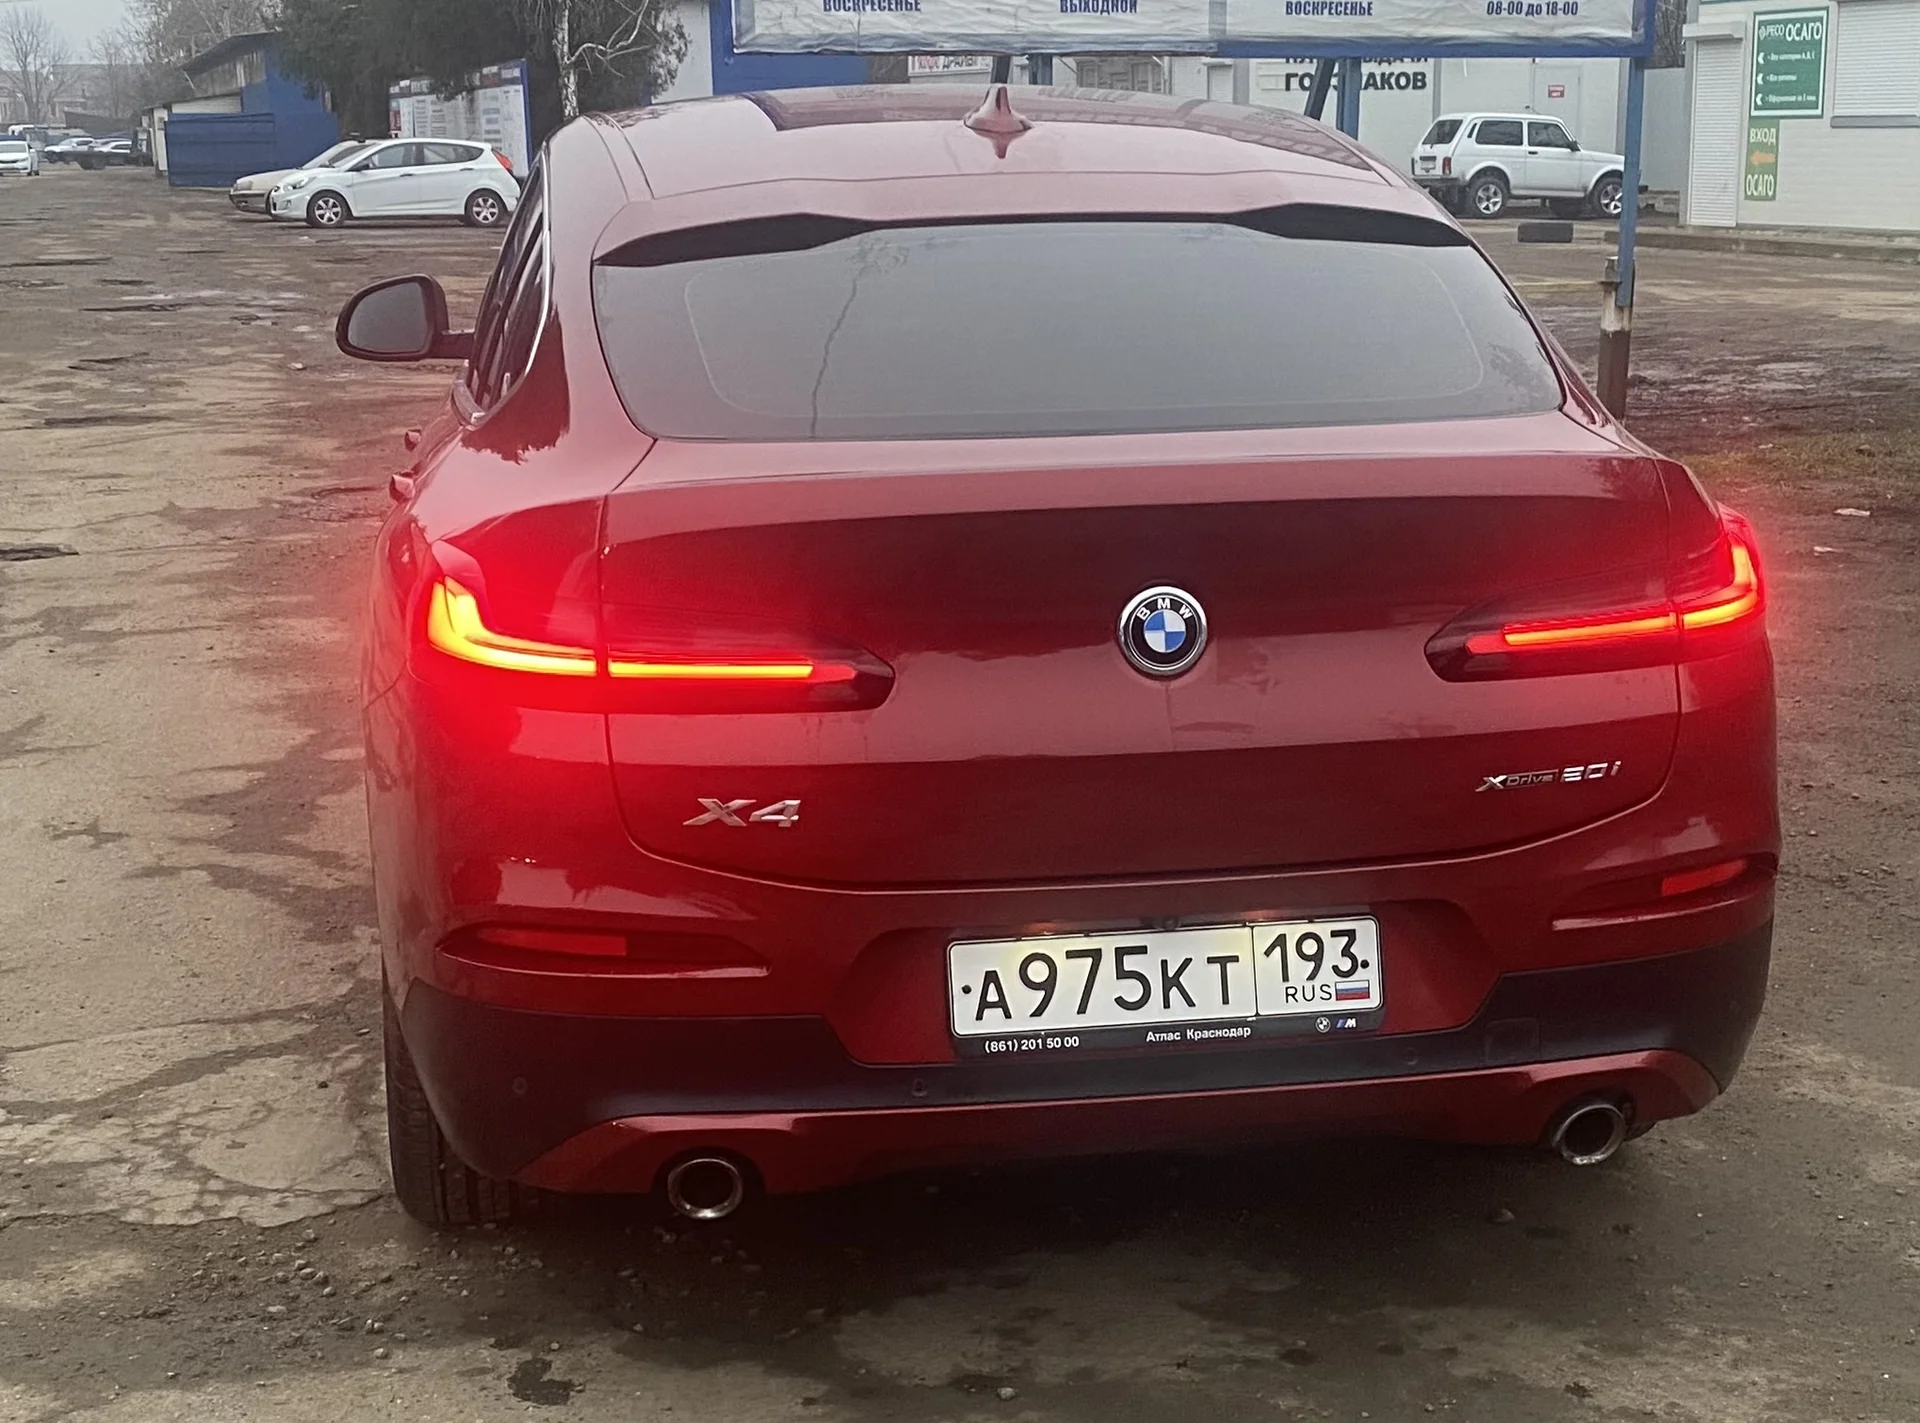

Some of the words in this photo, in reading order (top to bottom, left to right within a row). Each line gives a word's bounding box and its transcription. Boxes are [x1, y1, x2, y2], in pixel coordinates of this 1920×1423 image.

[823, 0, 921, 12] ВОСКРЕСЕНЬЕ
[1286, 1, 1373, 16] ВОСКРЕСЕНЬЕ
[1486, 1, 1523, 15] 08-00
[1525, 3, 1542, 17] до
[1545, 1, 1578, 15] 18-00
[1785, 21, 1822, 41] ОСАГО
[1750, 128, 1776, 146] ВХОД
[1746, 174, 1774, 197] ОСАГО
[1136, 597, 1193, 620] BMW
[683, 798, 801, 827] X4
[974, 945, 1240, 1021] А975КТ
[1262, 928, 1360, 982] 193
[1285, 983, 1333, 1003] RUS
[1145, 1028, 1181, 1043] Атлас
[1186, 1025, 1252, 1042] Краснодар
[984, 1038, 1019, 1053] (861)
[1021, 1036, 1045, 1051] 201
[1046, 1036, 1061, 1049] 50
[1063, 1035, 1080, 1048] 00
